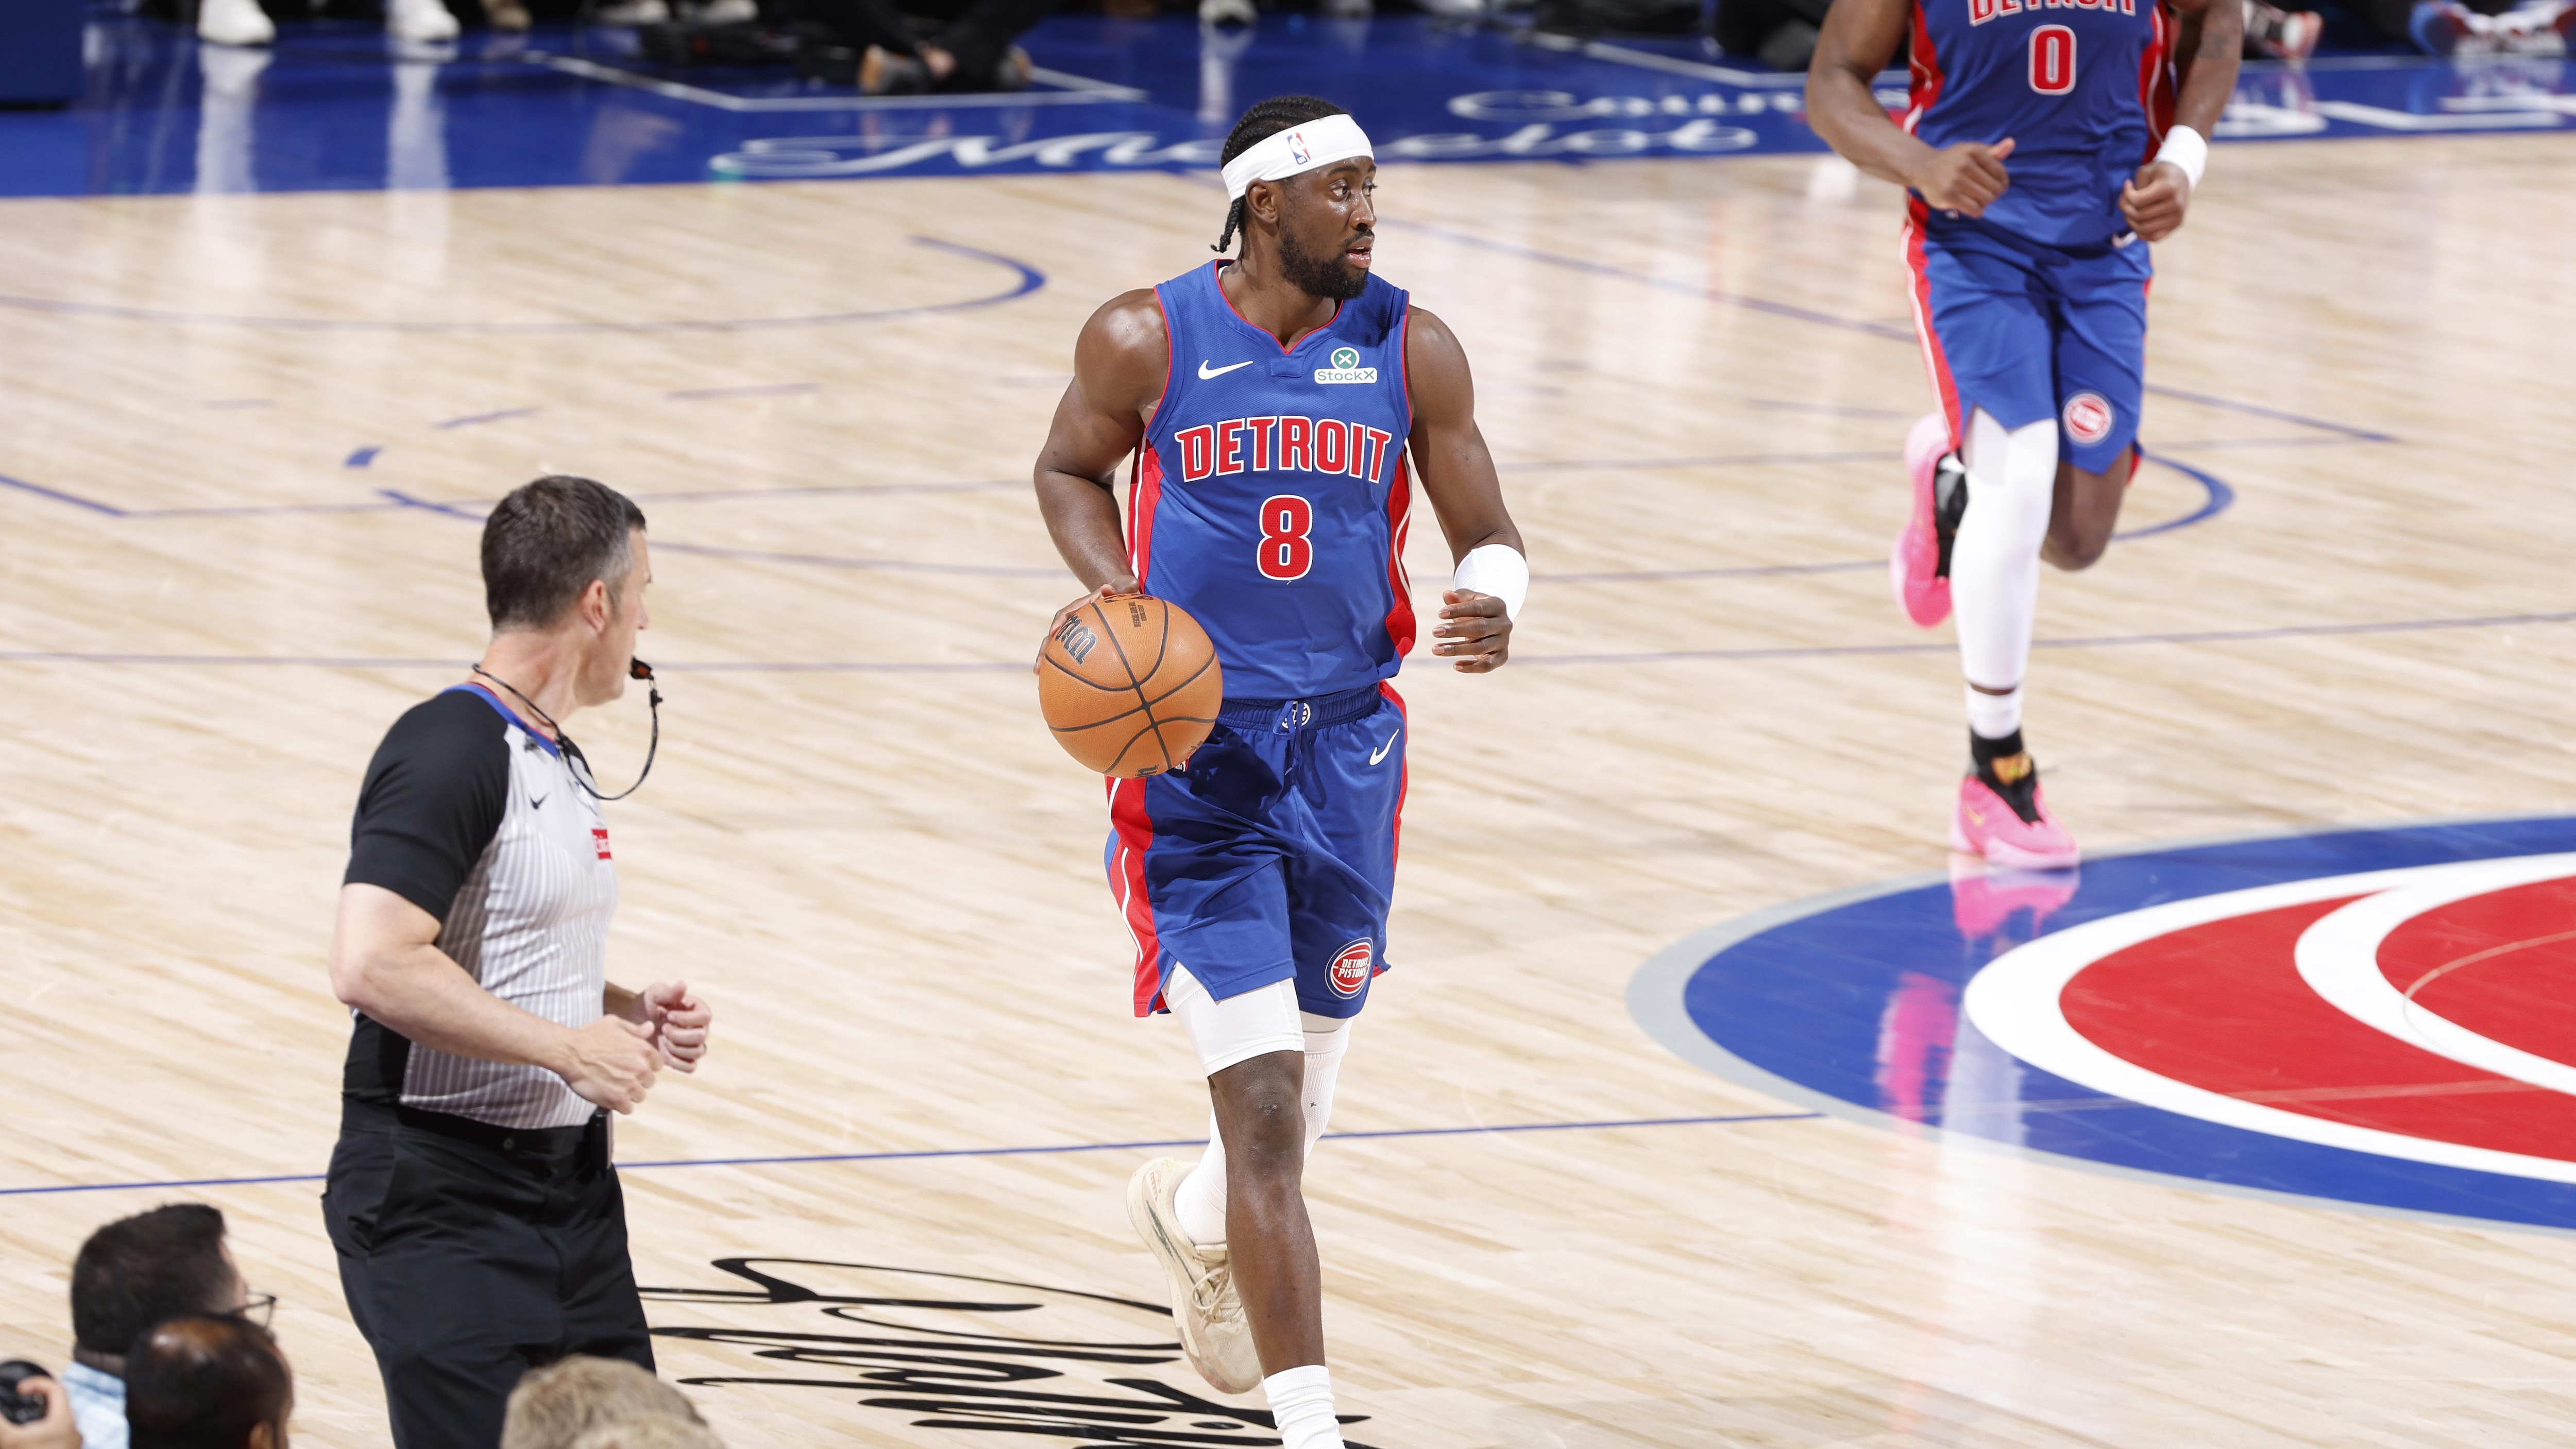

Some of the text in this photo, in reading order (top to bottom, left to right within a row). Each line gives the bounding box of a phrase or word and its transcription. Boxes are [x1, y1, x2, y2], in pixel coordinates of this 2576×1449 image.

[2028, 24, 2077, 95] 0
[1317, 370, 1375, 381] StockX
[1175, 416, 1392, 484] DETROIT
[1257, 495, 1313, 581] 8
[1338, 966, 1367, 978] PISTONS
[1342, 956, 1369, 968] DETROIT
